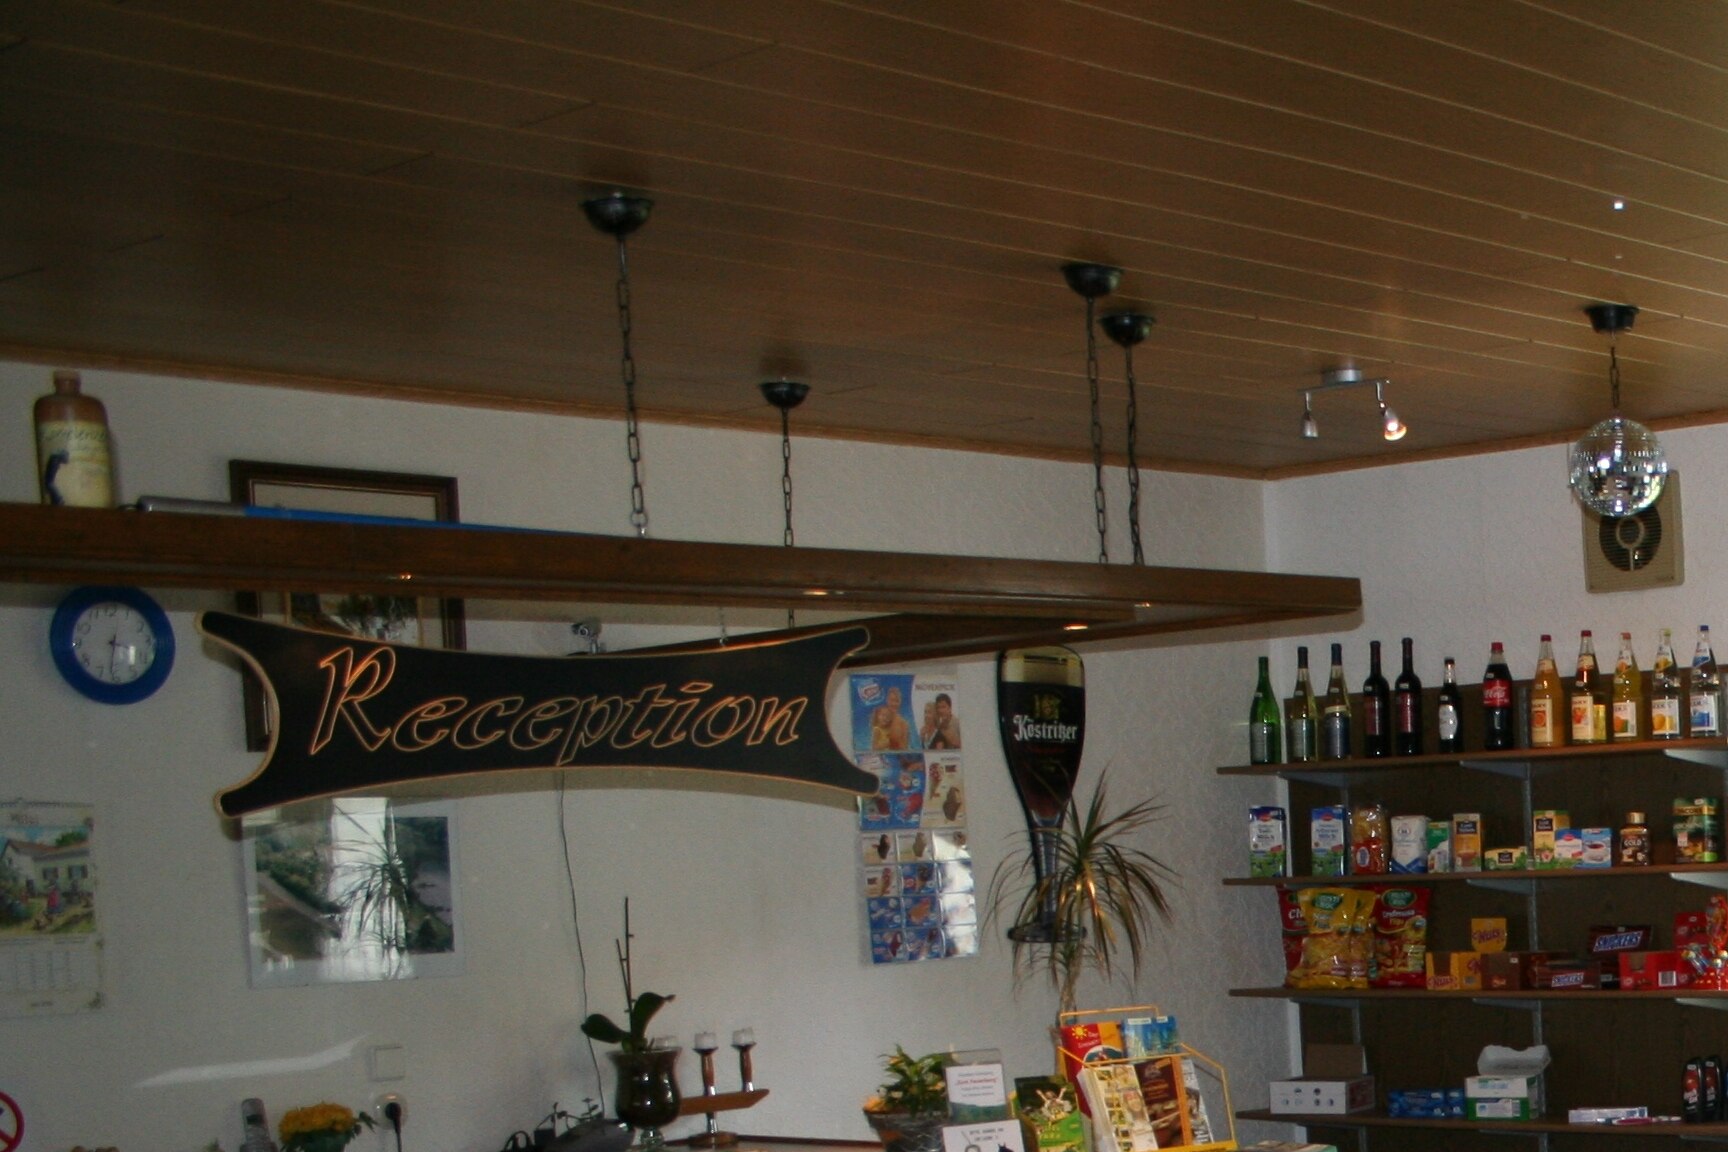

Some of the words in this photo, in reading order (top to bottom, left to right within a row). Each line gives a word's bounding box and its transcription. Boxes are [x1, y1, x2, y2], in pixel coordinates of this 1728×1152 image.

[309, 645, 809, 766] Reception
[1012, 714, 1078, 742] Köstritzer
[1594, 931, 1643, 952] SNICKERS
